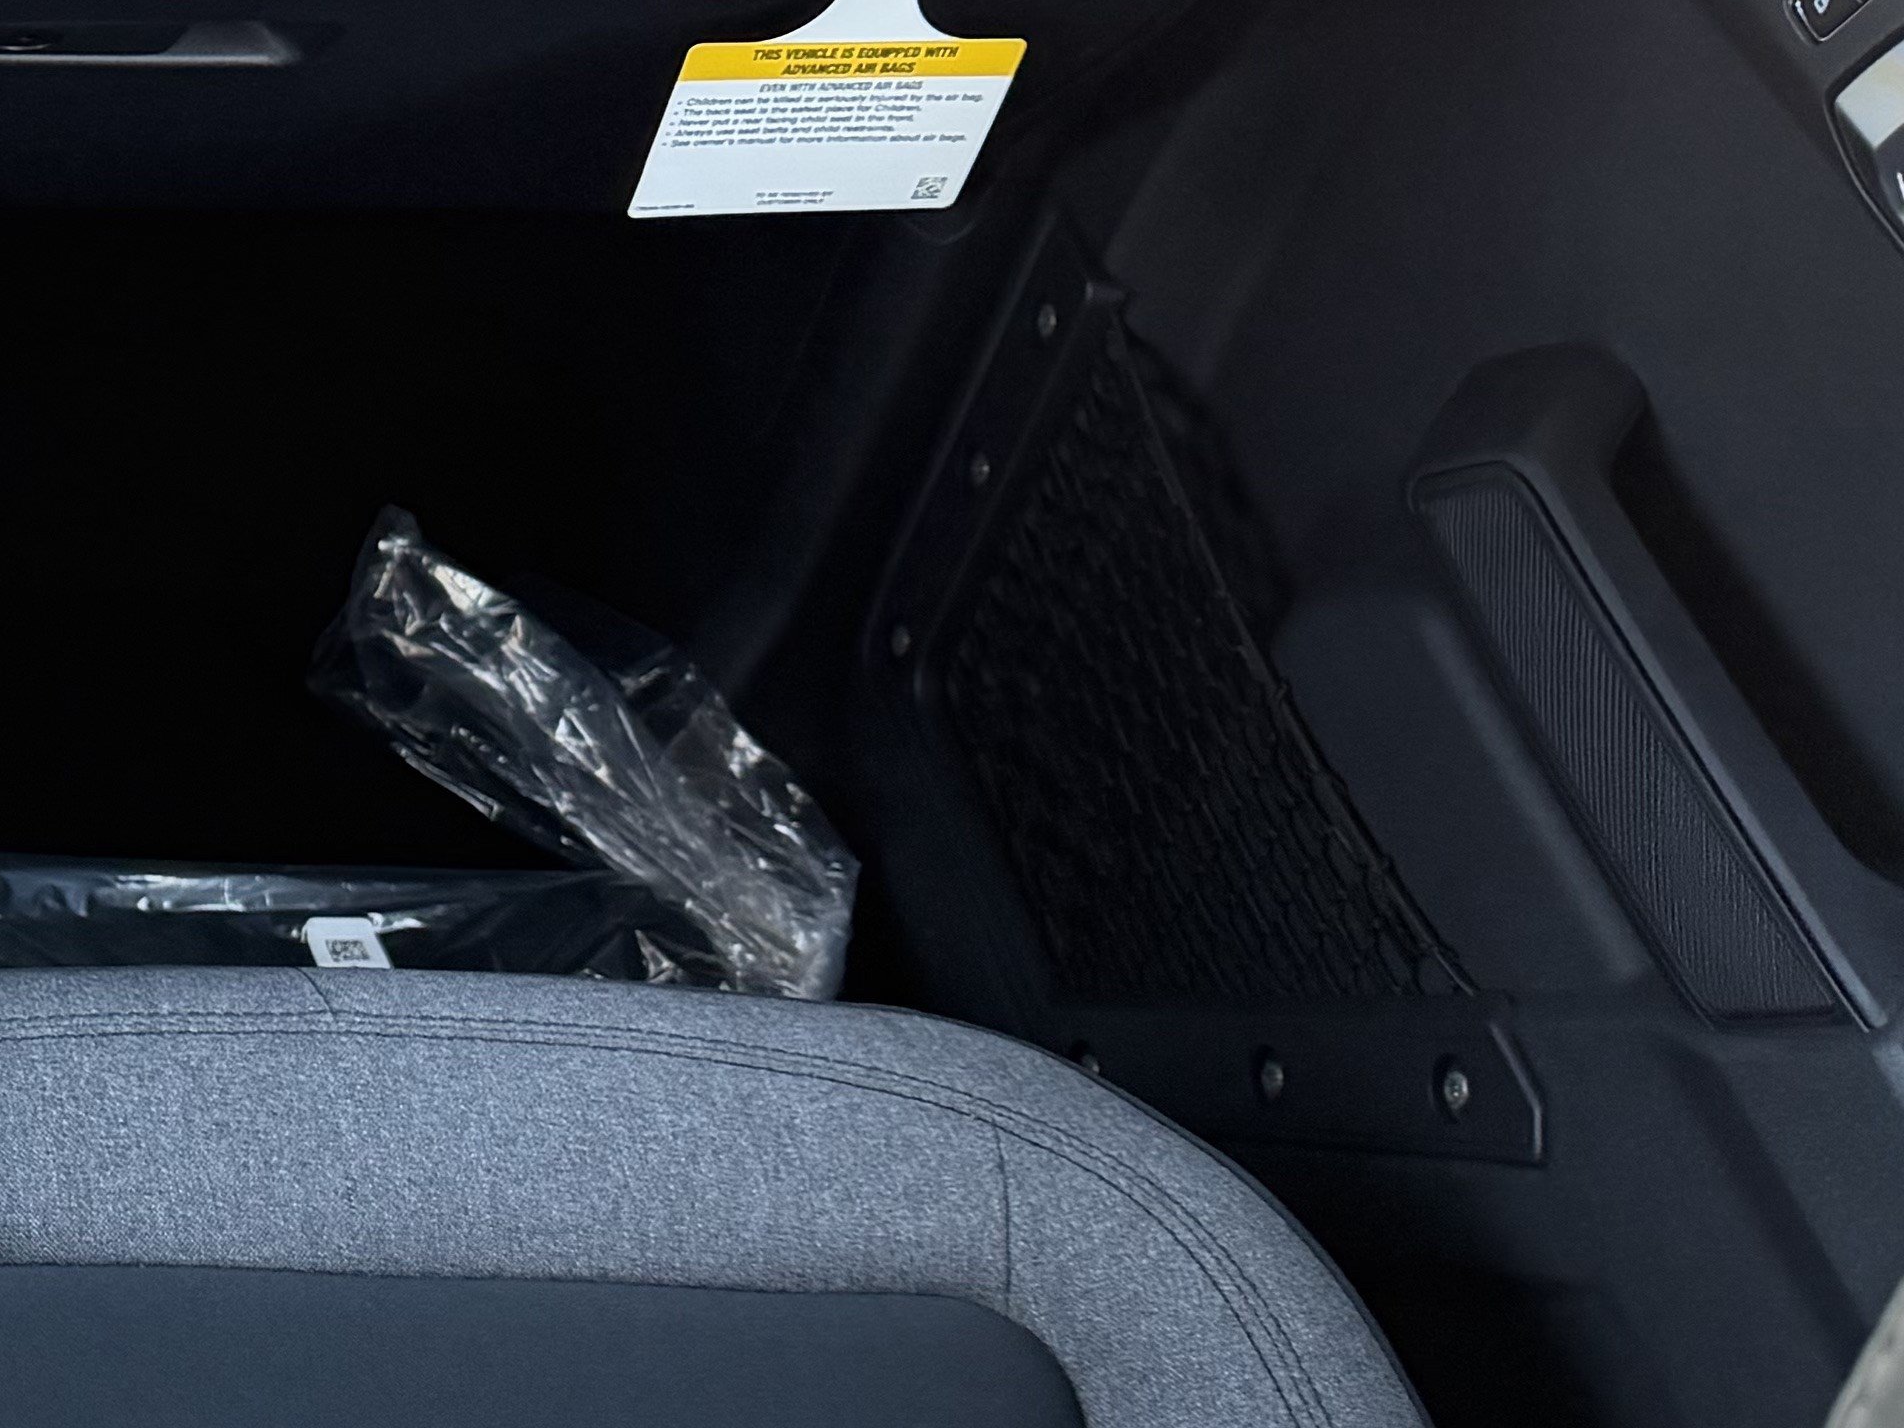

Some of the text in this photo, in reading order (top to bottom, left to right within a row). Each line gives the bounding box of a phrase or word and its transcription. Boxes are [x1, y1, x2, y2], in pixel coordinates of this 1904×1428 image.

[753, 46, 960, 61] THIS VEHICLE IS EQUIPPED WITH
[781, 62, 917, 75] ADVANCED AIR BAGS
